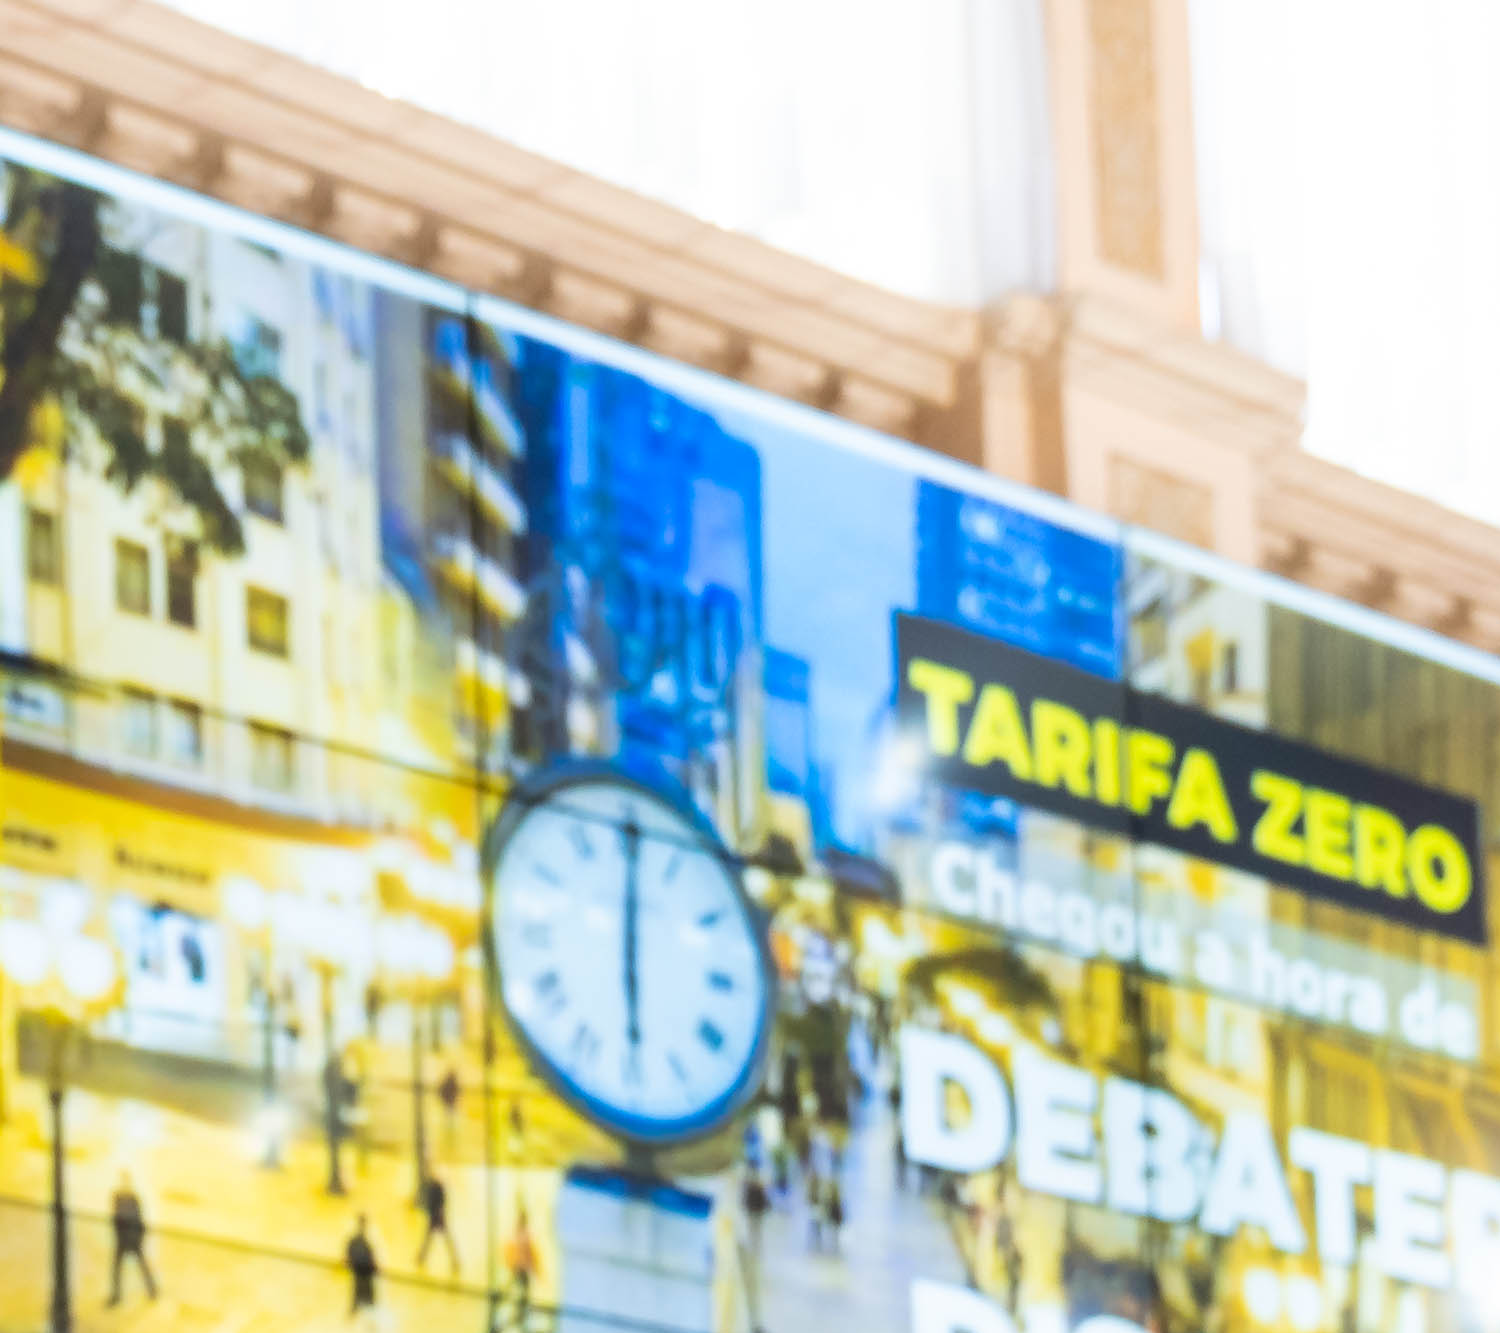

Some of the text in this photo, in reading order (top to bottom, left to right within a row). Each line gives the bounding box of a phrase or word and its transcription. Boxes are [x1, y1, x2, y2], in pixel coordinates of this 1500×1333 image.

[908, 659, 1471, 913] TARIFA ZERO
[931, 845, 1477, 1060] Chegou a hora de
